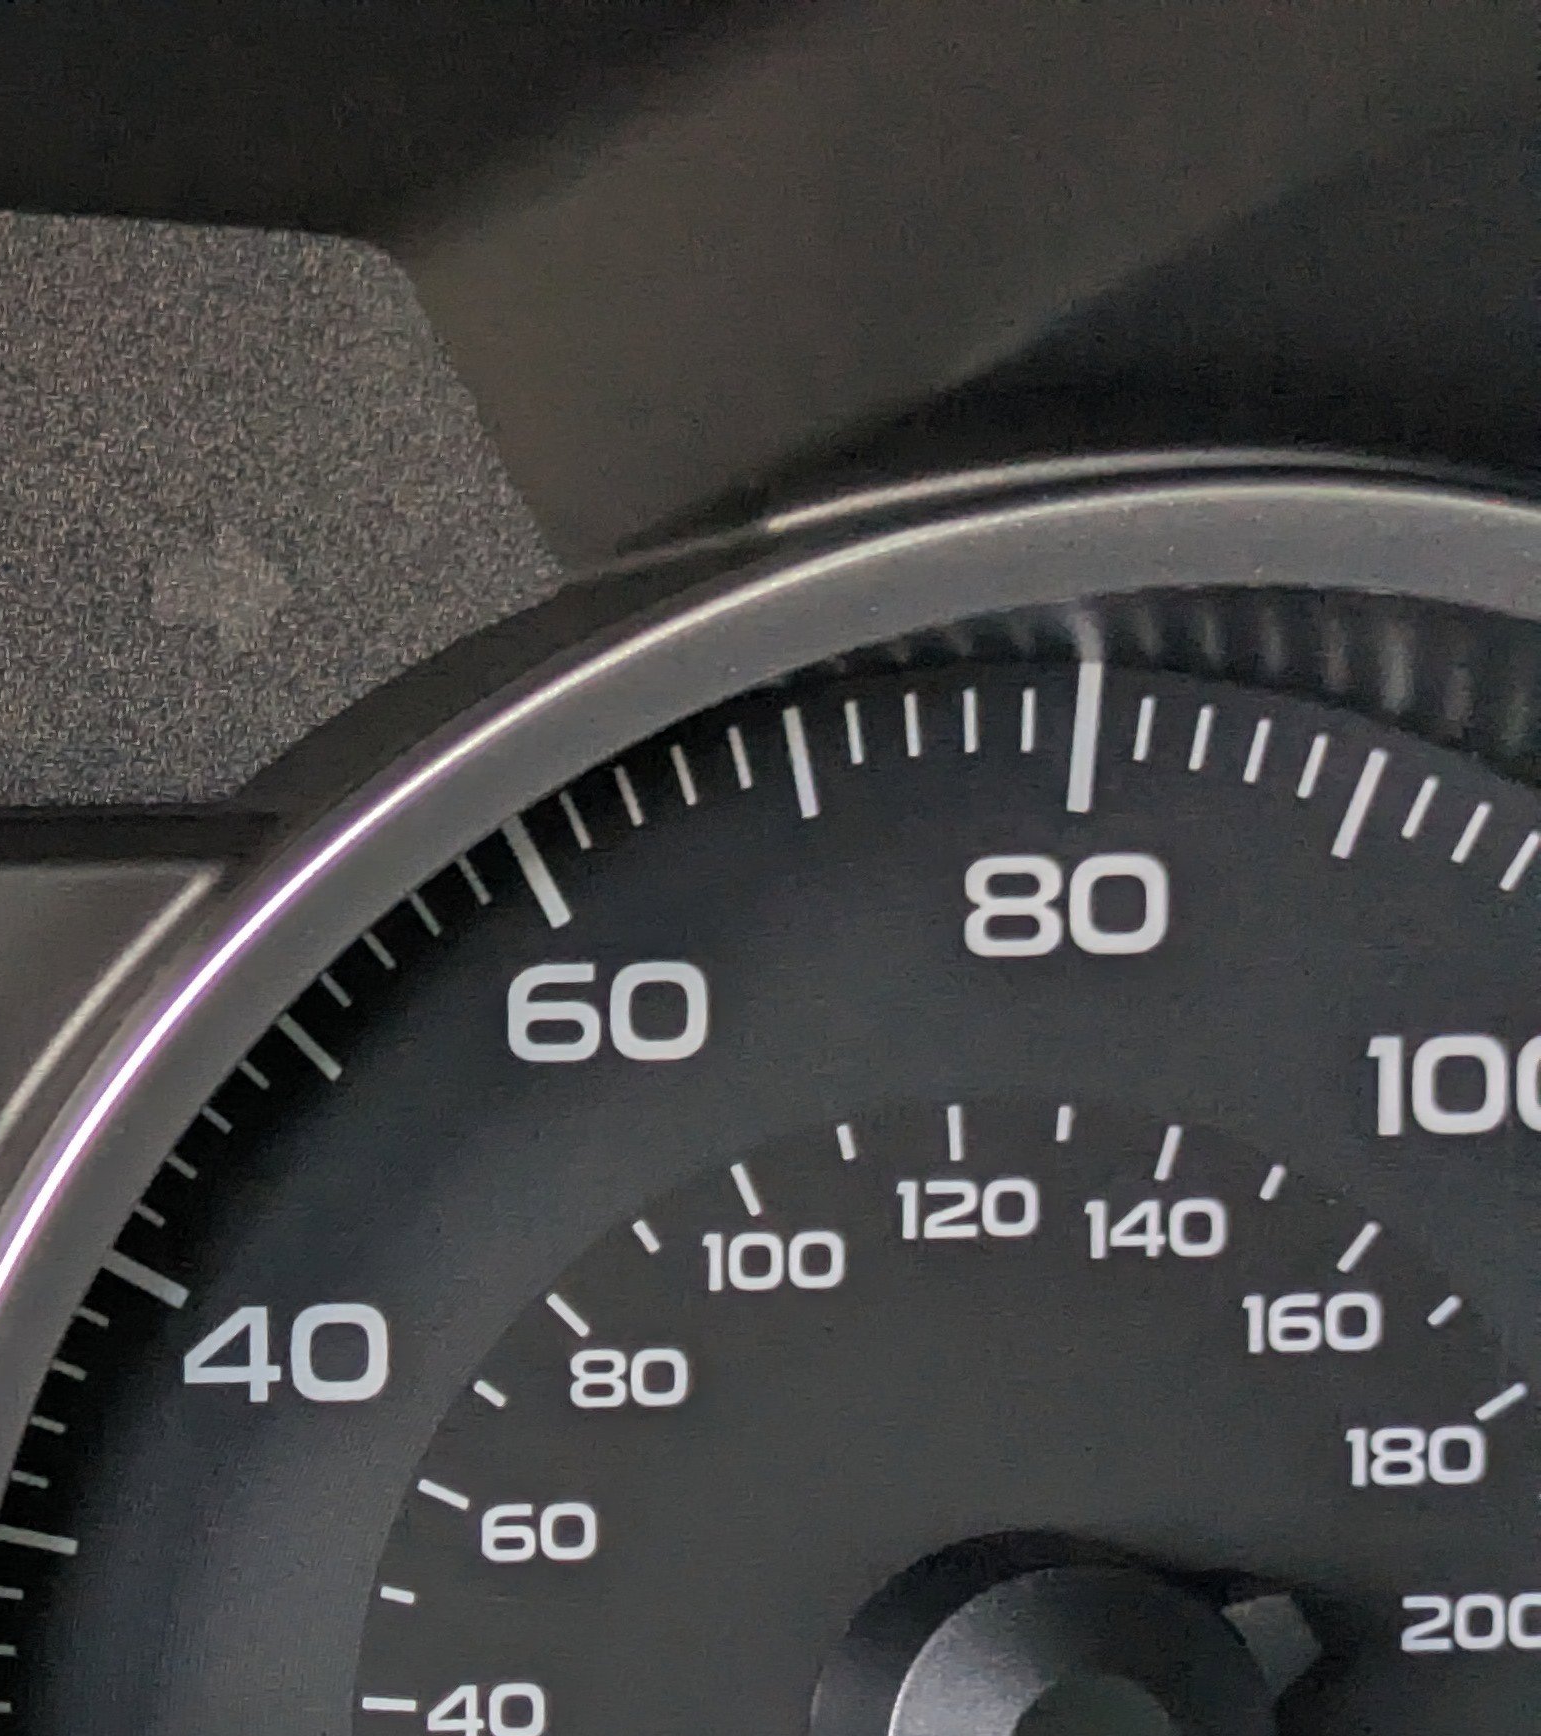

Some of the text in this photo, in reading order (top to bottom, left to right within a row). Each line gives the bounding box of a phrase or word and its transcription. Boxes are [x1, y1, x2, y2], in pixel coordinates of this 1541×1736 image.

[964, 853, 1168, 957] 80
[507, 961, 709, 1063] 60
[1367, 1034, 1541, 1136] 10
[896, 1177, 1039, 1240] 120
[1084, 1198, 1227, 1259] 140
[702, 1230, 845, 1292] 100
[182, 1303, 390, 1403] 40
[1242, 1291, 1382, 1354] 160
[570, 1348, 689, 1408] 80
[1345, 1425, 1486, 1487] 180
[481, 1501, 598, 1562] 60
